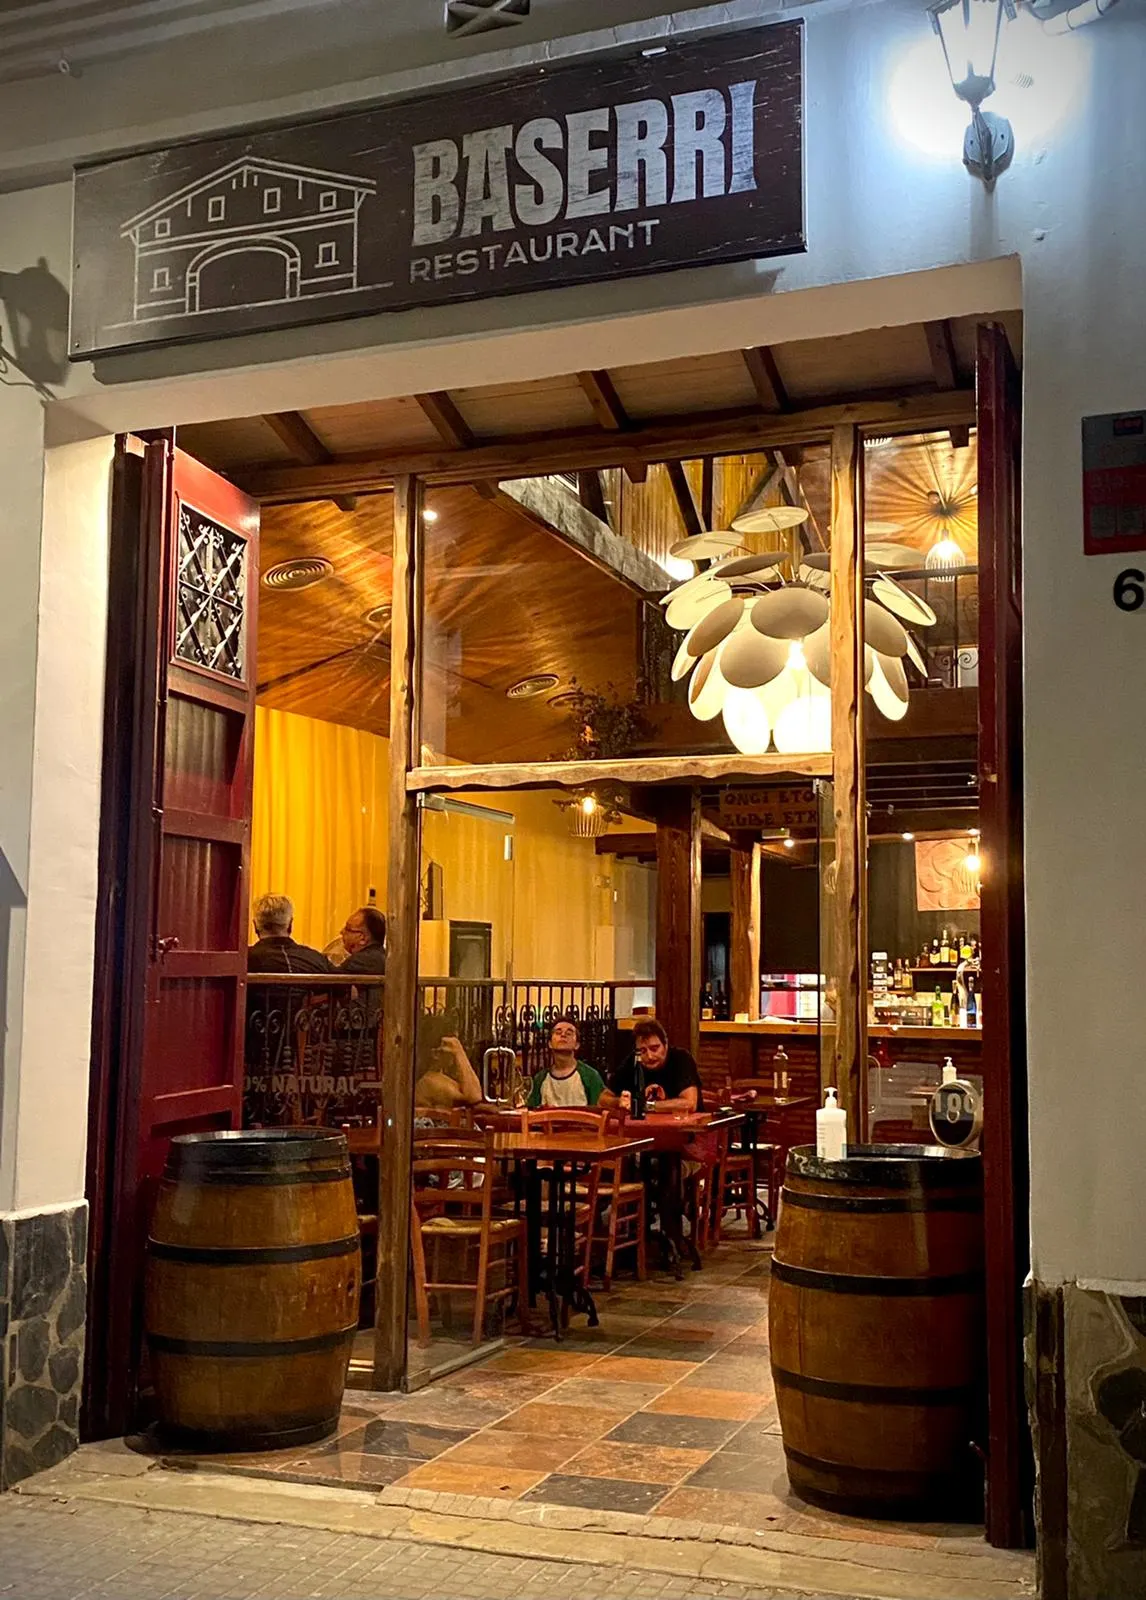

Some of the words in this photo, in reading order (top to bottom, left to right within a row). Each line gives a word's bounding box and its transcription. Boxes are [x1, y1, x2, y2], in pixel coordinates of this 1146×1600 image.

[412, 80, 757, 247] BASERRI
[409, 218, 660, 284] RESTAURANT
[1113, 568, 1145, 612] 6
[271, 1074, 359, 1096] NATURAL
